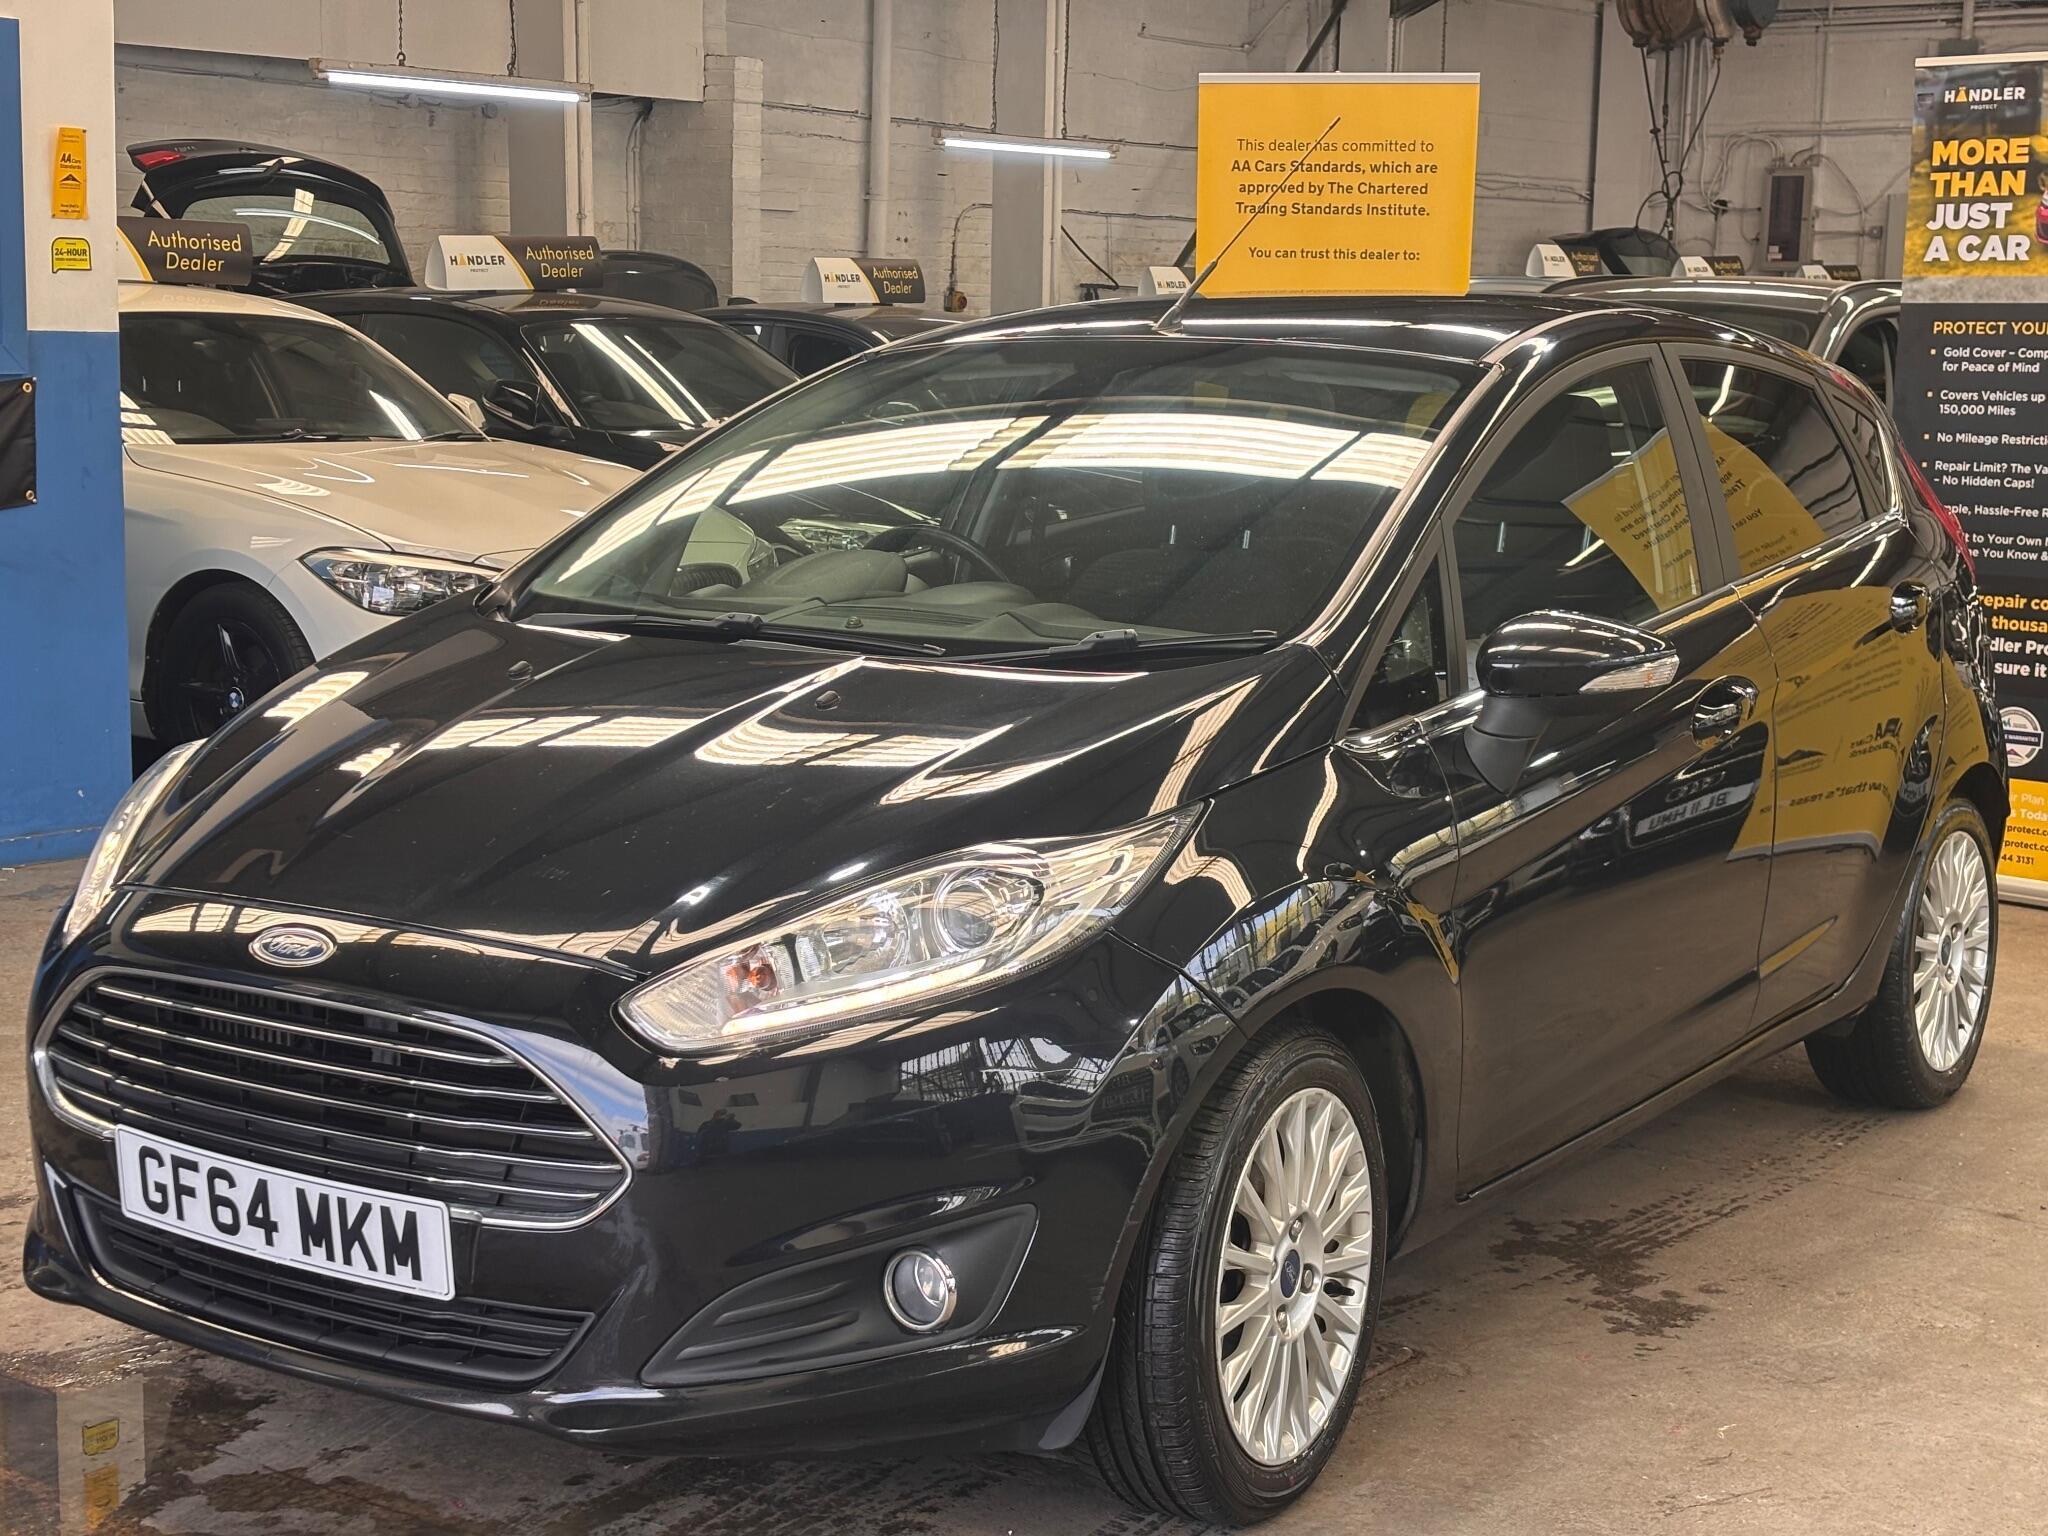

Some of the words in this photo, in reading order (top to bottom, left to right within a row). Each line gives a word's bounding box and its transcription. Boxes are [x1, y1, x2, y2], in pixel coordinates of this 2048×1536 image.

[1237, 139, 1265, 151] This
[1268, 139, 1311, 152] dealer
[1315, 140, 1338, 152] has
[1342, 140, 1416, 152] committed
[1420, 141, 1434, 152] to
[1932, 137, 2030, 167] MORE
[1231, 159, 1251, 172] AA
[1254, 159, 1286, 173] Cars
[1290, 160, 1366, 175] Standards,
[1370, 161, 1411, 174] which
[1415, 163, 1438, 174] are
[1239, 182, 1304, 196] approved
[1308, 182, 1324, 197] by
[1328, 182, 1353, 194] The
[1357, 182, 1428, 195] Chartered
[1930, 170, 2026, 198] THAN
[1235, 202, 1287, 217] Trading
[1291, 202, 1362, 216] Standards
[1367, 204, 1430, 217] Institute.
[1926, 203, 2013, 230] JUST
[148, 230, 241, 252] Authorised
[55, 247, 87, 257] 24-HOUR
[526, 245, 594, 261] Authorised
[1249, 247, 1272, 259] You
[1275, 249, 1297, 259] can
[1300, 249, 1330, 260] trust
[1333, 248, 1357, 260] this
[1360, 249, 1399, 260] dealer
[1403, 250, 1420, 261] to:
[1923, 235, 1950, 262] A
[1957, 235, 2030, 262] CAR
[166, 252, 225, 273] Dealer
[541, 263, 583, 278] Dealer
[873, 266, 919, 279] Authorised
[883, 281, 912, 294] Dealer
[1933, 321, 2007, 335] PROTECT
[1943, 347, 1970, 358] Gold
[1973, 347, 2006, 358] Cover
[1942, 361, 1959, 372] for
[1961, 362, 1994, 372] Peace
[1997, 362, 2010, 372] of
[2012, 362, 2040, 373] Mind
[1940, 390, 1978, 401] Covers
[1981, 391, 2028, 402] Vehicles
[2031, 393, 2046, 404] up
[1939, 404, 1985, 416] 150,000
[1987, 405, 2016, 416] Miles
[1937, 432, 1953, 442] No
[1955, 433, 1999, 445] Mileage
[2001, 434, 2048, 446] Restricti
[1935, 461, 1971, 473] Repair
[1973, 462, 2008, 473] Limit?
[2010, 463, 2031, 474] The
[1943, 475, 1958, 486] No
[1961, 476, 2001, 487] Hidden
[2004, 477, 2035, 490] Caps!
[1975, 505, 2039, 518] Hassle-Free
[1972, 533, 1984, 543] to
[1987, 533, 2014, 545] Your
[2016, 535, 2042, 546] Own
[1982, 548, 2003, 558] You
[2006, 549, 2038, 560] Know
[1994, 662, 2030, 677] sure
[2034, 662, 2047, 678] it
[2021, 792, 2045, 805] Plan
[2016, 855, 2034, 864] 3131
[138, 1144, 280, 1248] GF64
[295, 1186, 424, 1282] MKM
